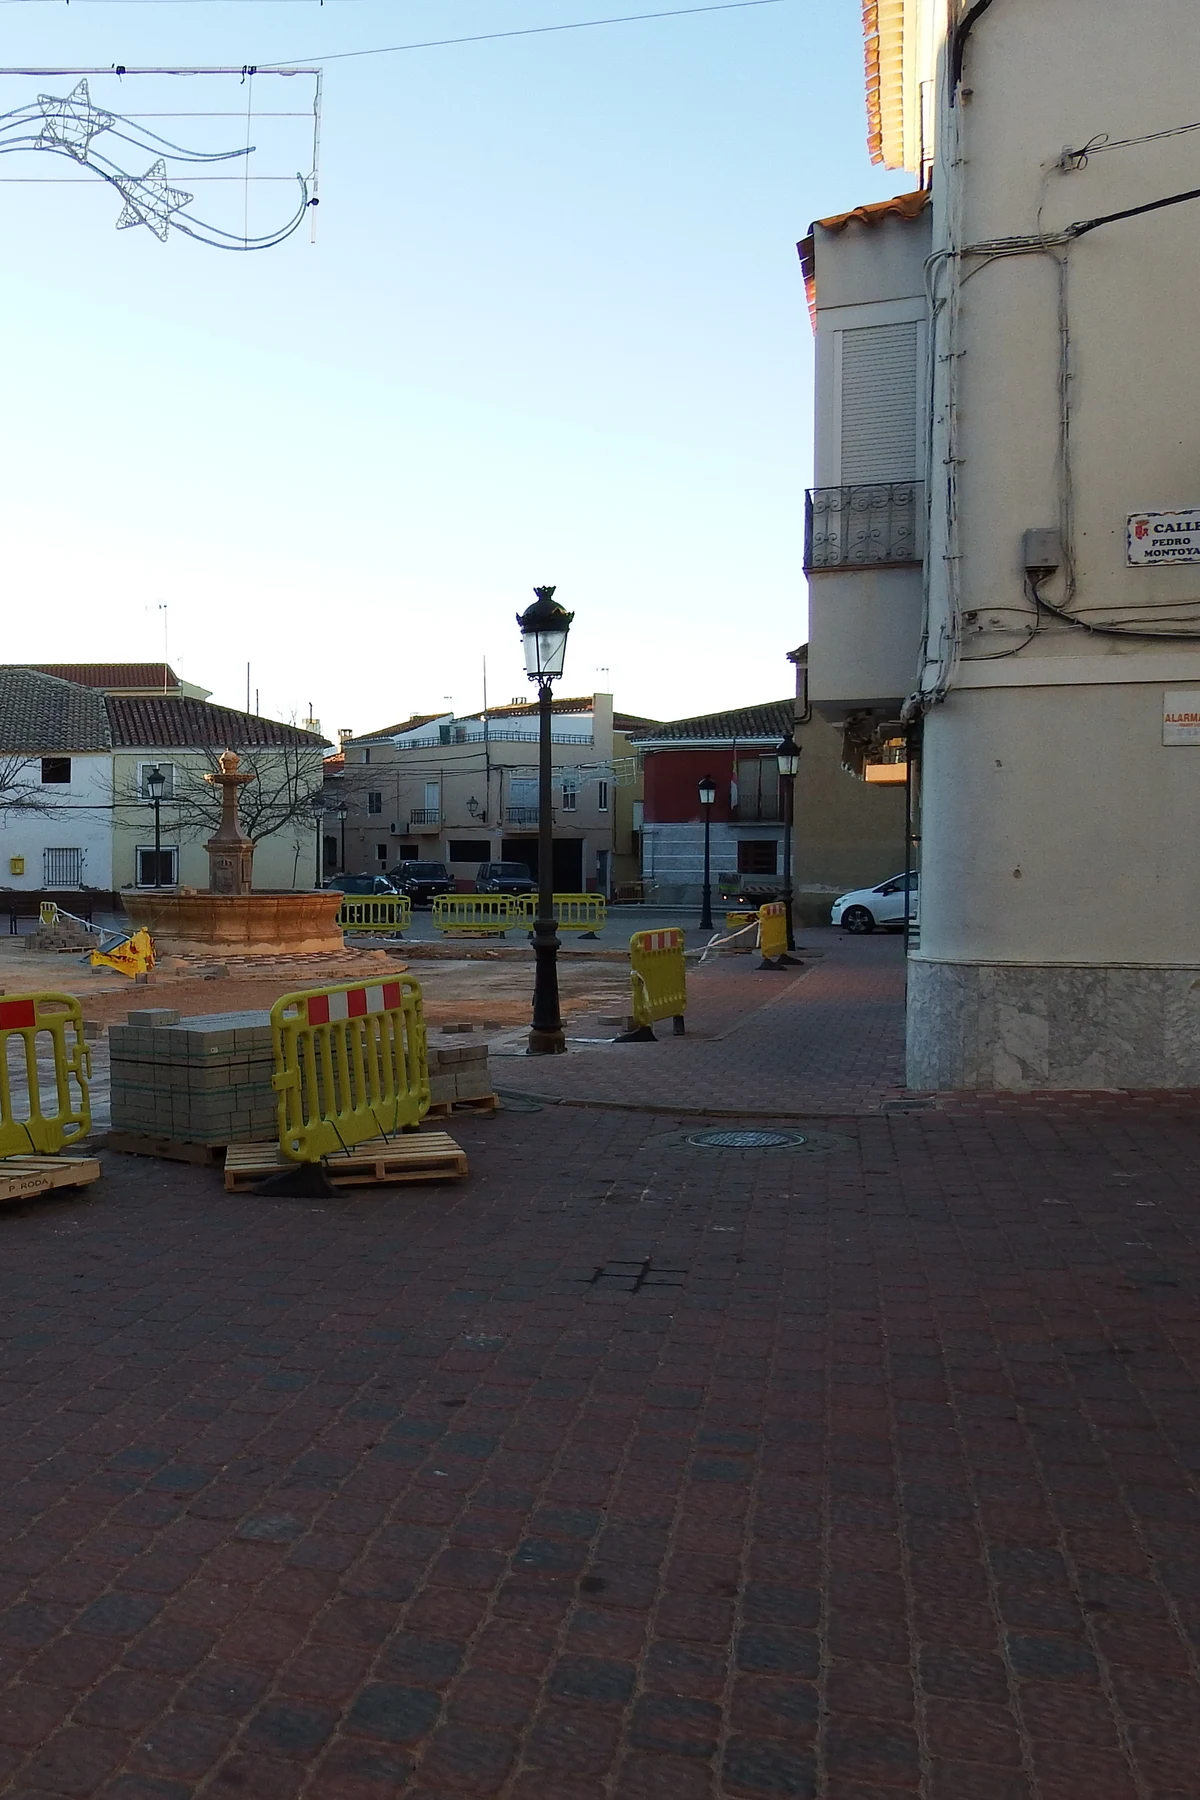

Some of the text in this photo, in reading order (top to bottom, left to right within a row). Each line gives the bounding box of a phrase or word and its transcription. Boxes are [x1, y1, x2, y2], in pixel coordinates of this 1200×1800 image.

[1153, 521, 1200, 533] CALLE
[1151, 537, 1191, 546] PEDRO
[1144, 547, 1200, 557] MONTOYA
[1164, 713, 1200, 723] ALARM
[20, 1179, 49, 1190] RODA
